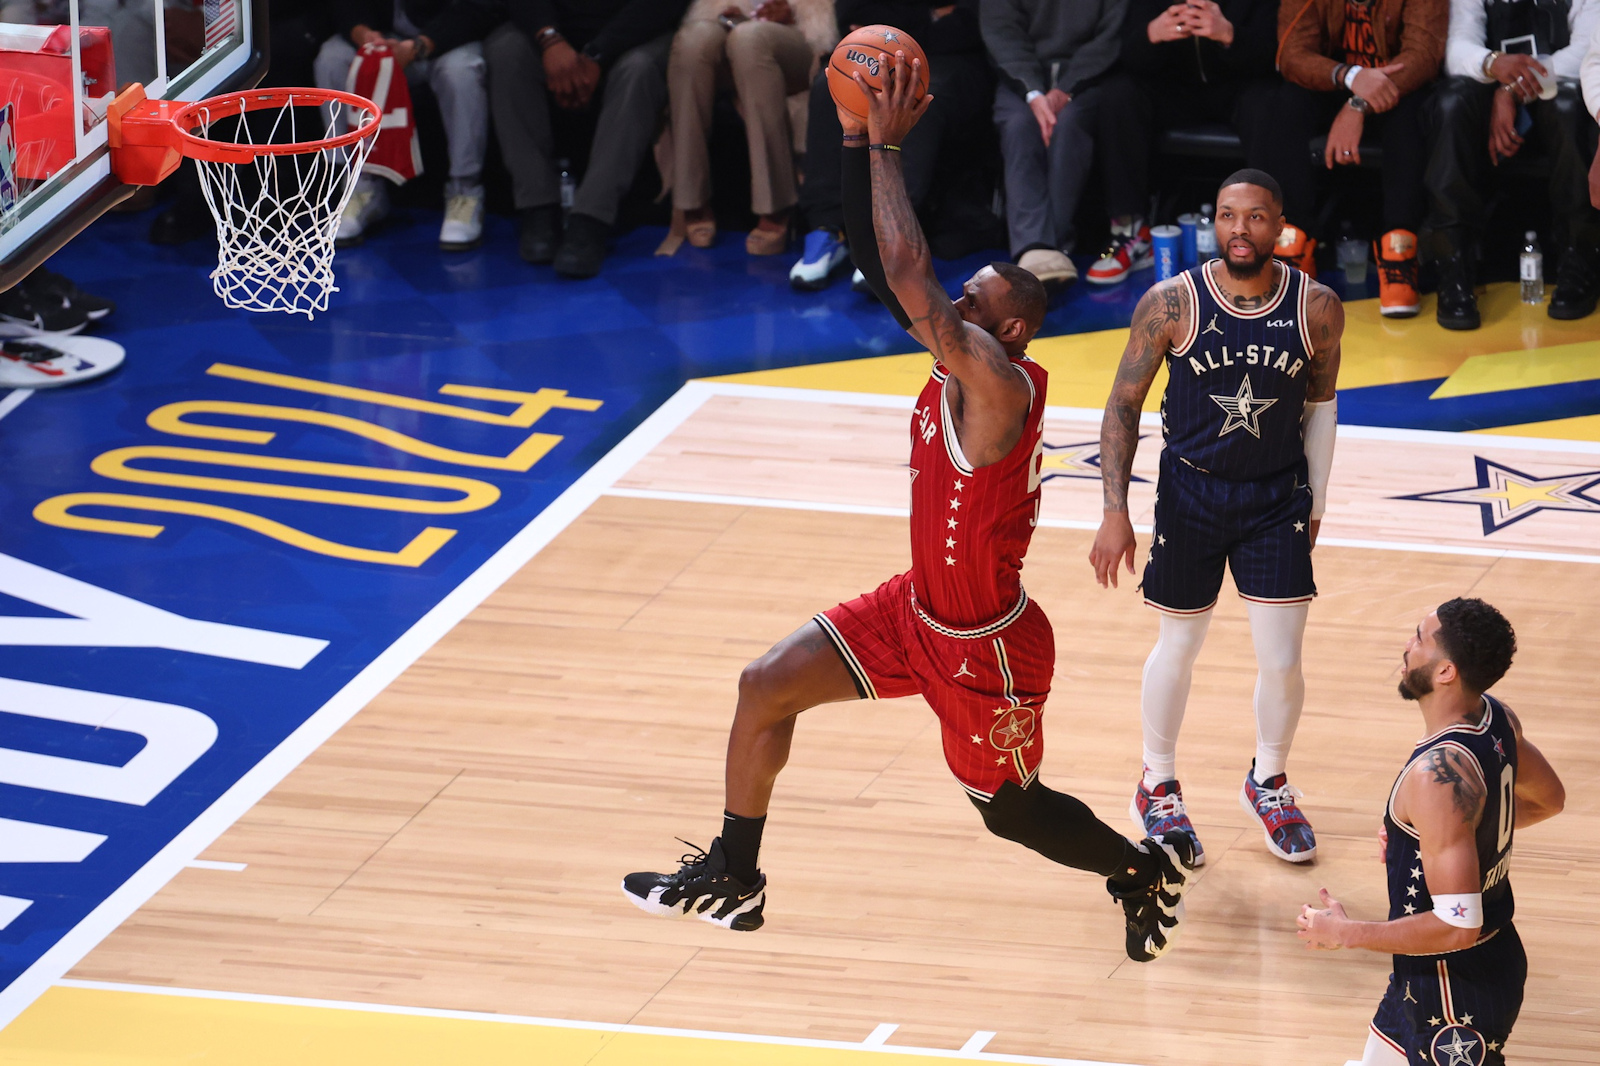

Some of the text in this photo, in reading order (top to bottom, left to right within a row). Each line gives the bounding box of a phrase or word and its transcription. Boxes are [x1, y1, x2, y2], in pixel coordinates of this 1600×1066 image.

[1188, 344, 1304, 379] ALL-STAR
[32, 362, 604, 567] 2024
[1497, 763, 1513, 854] 0
